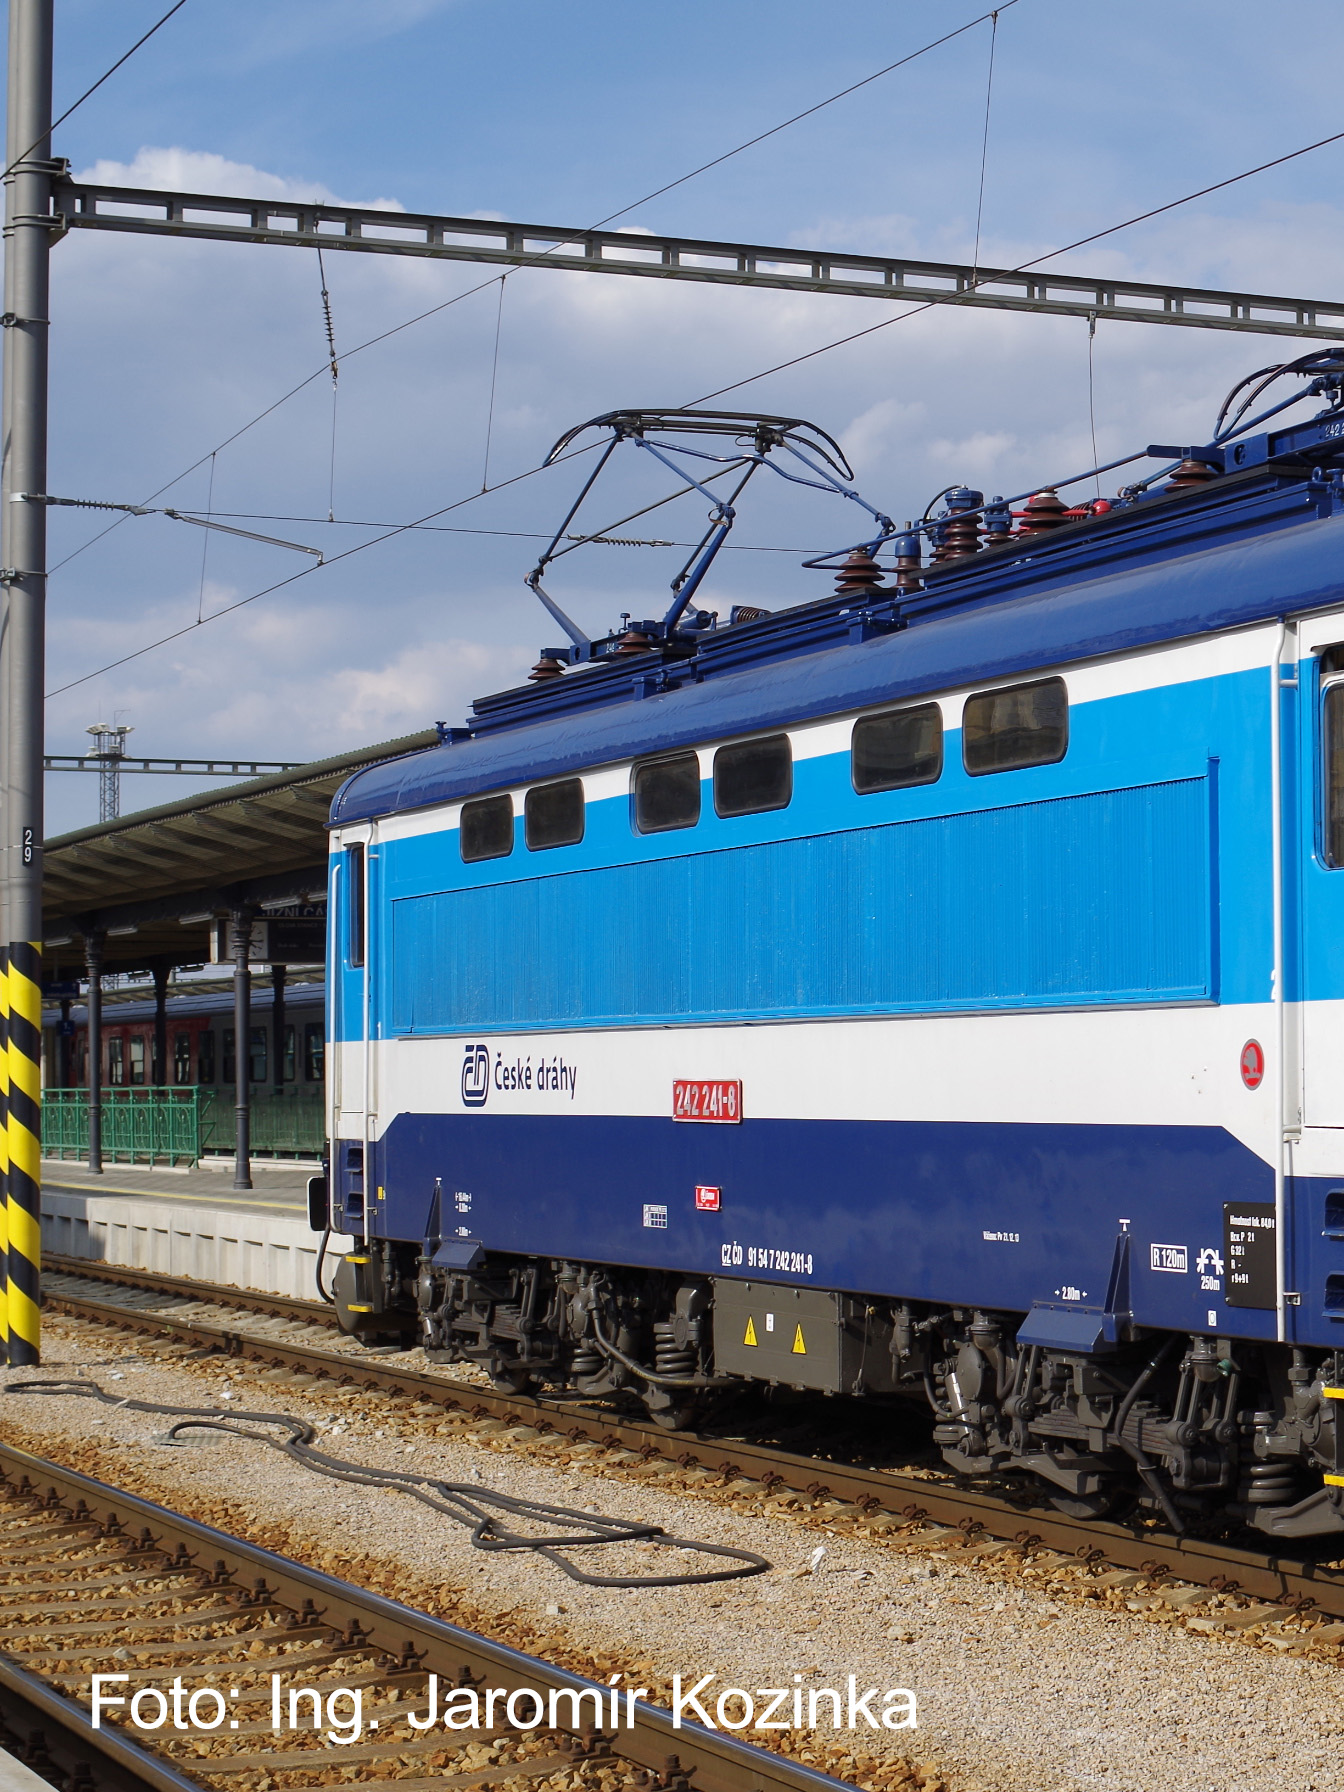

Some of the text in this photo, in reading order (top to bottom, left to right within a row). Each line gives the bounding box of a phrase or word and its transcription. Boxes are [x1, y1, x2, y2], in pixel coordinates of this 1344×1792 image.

[1325, 423, 1340, 437] 242
[24, 829, 32, 862] 29
[495, 1051, 577, 1100] České dráhy
[676, 1085, 736, 1117] 242 241-8
[721, 1240, 813, 1275] CZ ČD 91 54 7 242 241-8
[1154, 1248, 1185, 1269] R 120m
[1200, 1275, 1220, 1291] 250m
